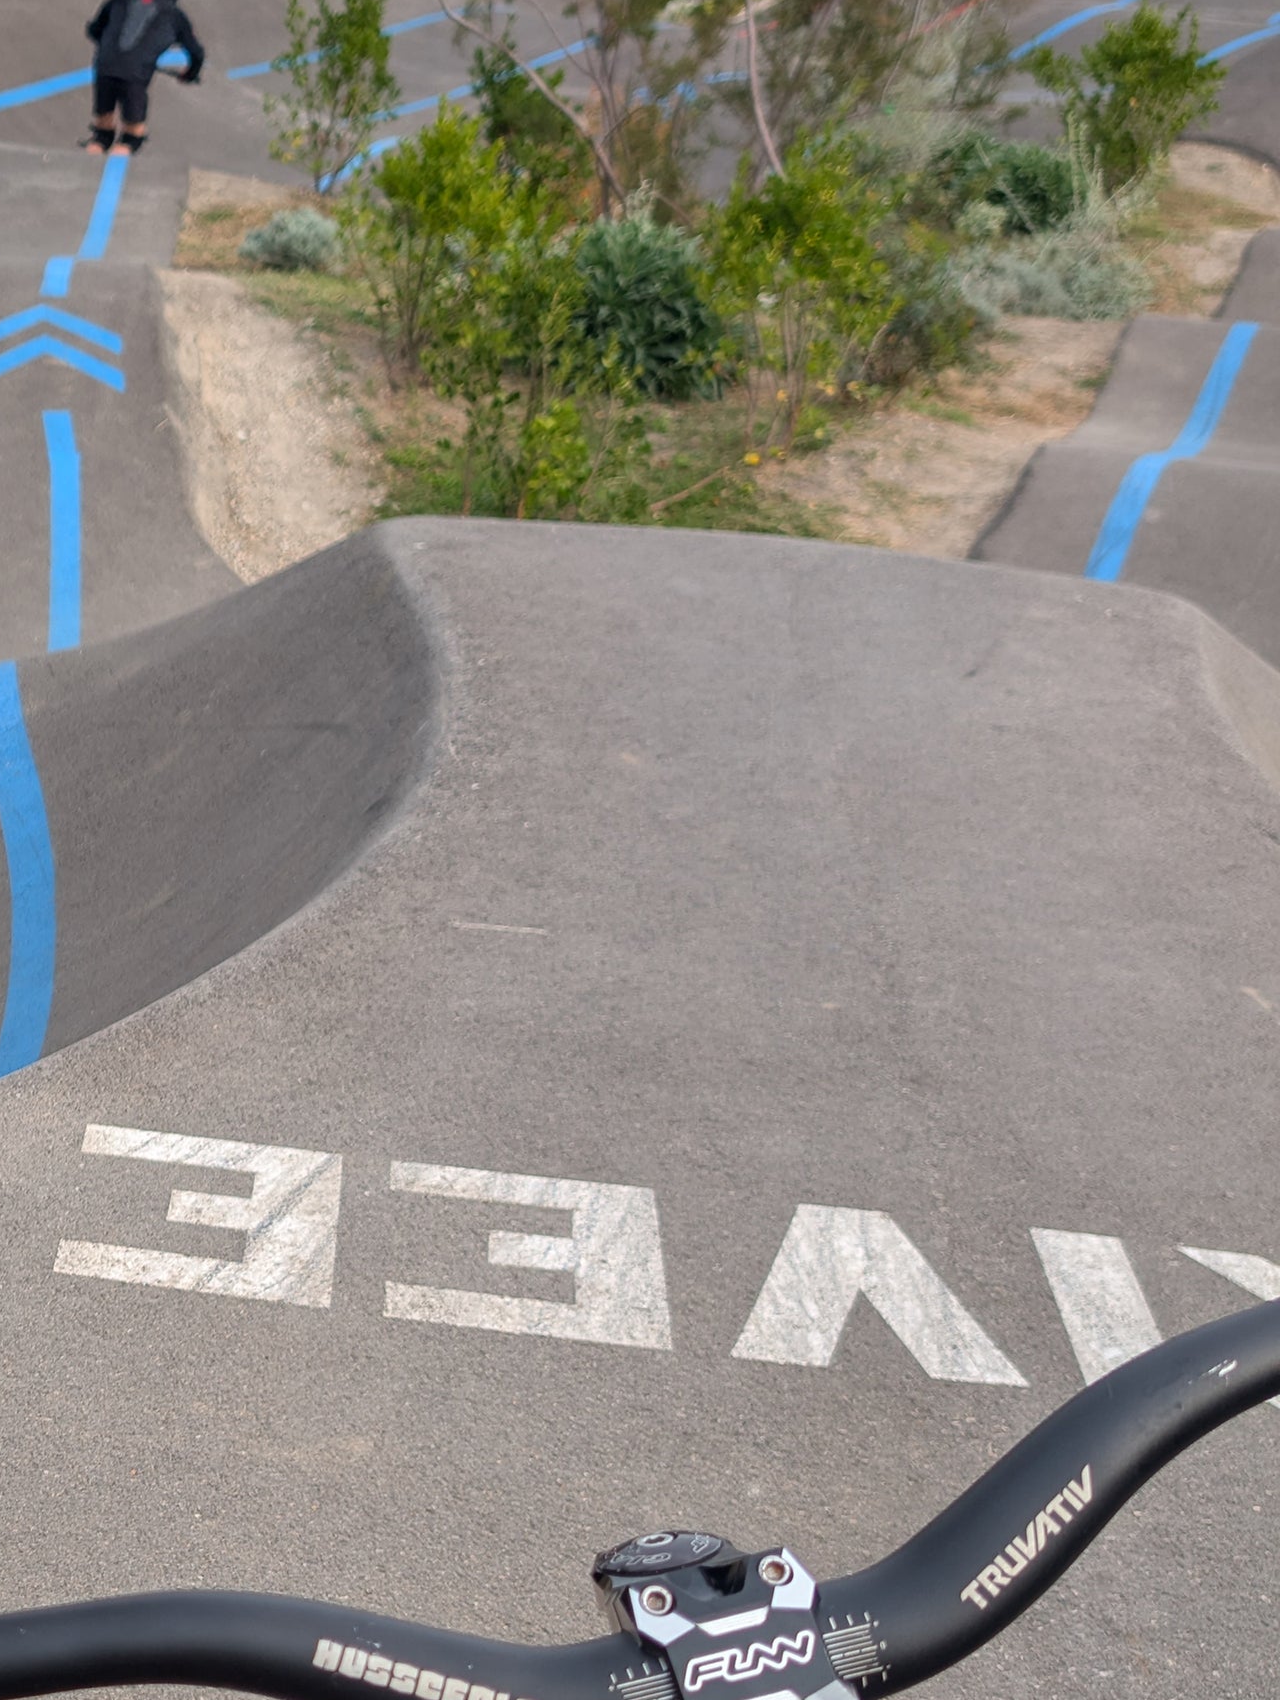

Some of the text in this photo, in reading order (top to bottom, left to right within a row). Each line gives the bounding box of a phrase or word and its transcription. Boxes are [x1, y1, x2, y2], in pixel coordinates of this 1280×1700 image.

[53, 1123, 1280, 1410] IVEE
[960, 1463, 1092, 1610] TRUVATIV
[684, 1630, 816, 1691] FUNN
